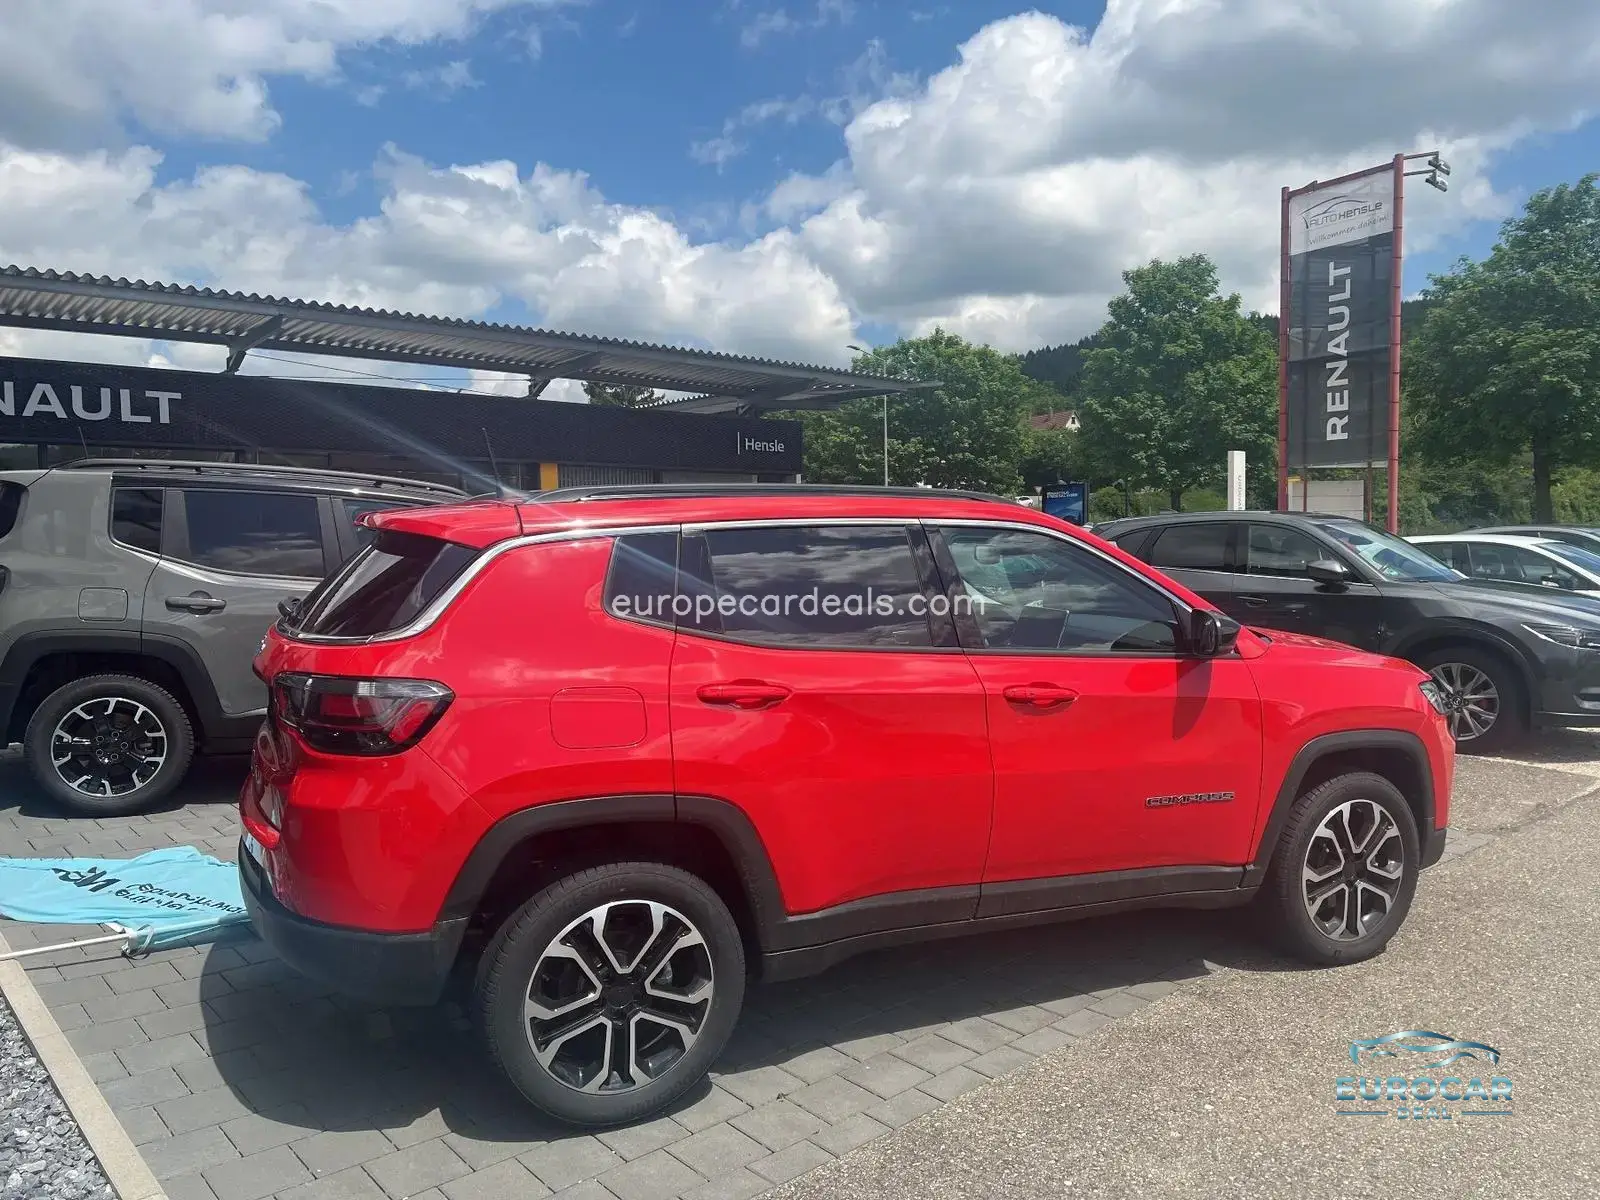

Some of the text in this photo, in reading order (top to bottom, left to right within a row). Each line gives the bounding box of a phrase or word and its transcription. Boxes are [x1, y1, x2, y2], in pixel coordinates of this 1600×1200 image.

[1326, 261, 1351, 441] RENAULT
[744, 438, 785, 452] Hensle
[1145, 791, 1235, 809] COMPASS
